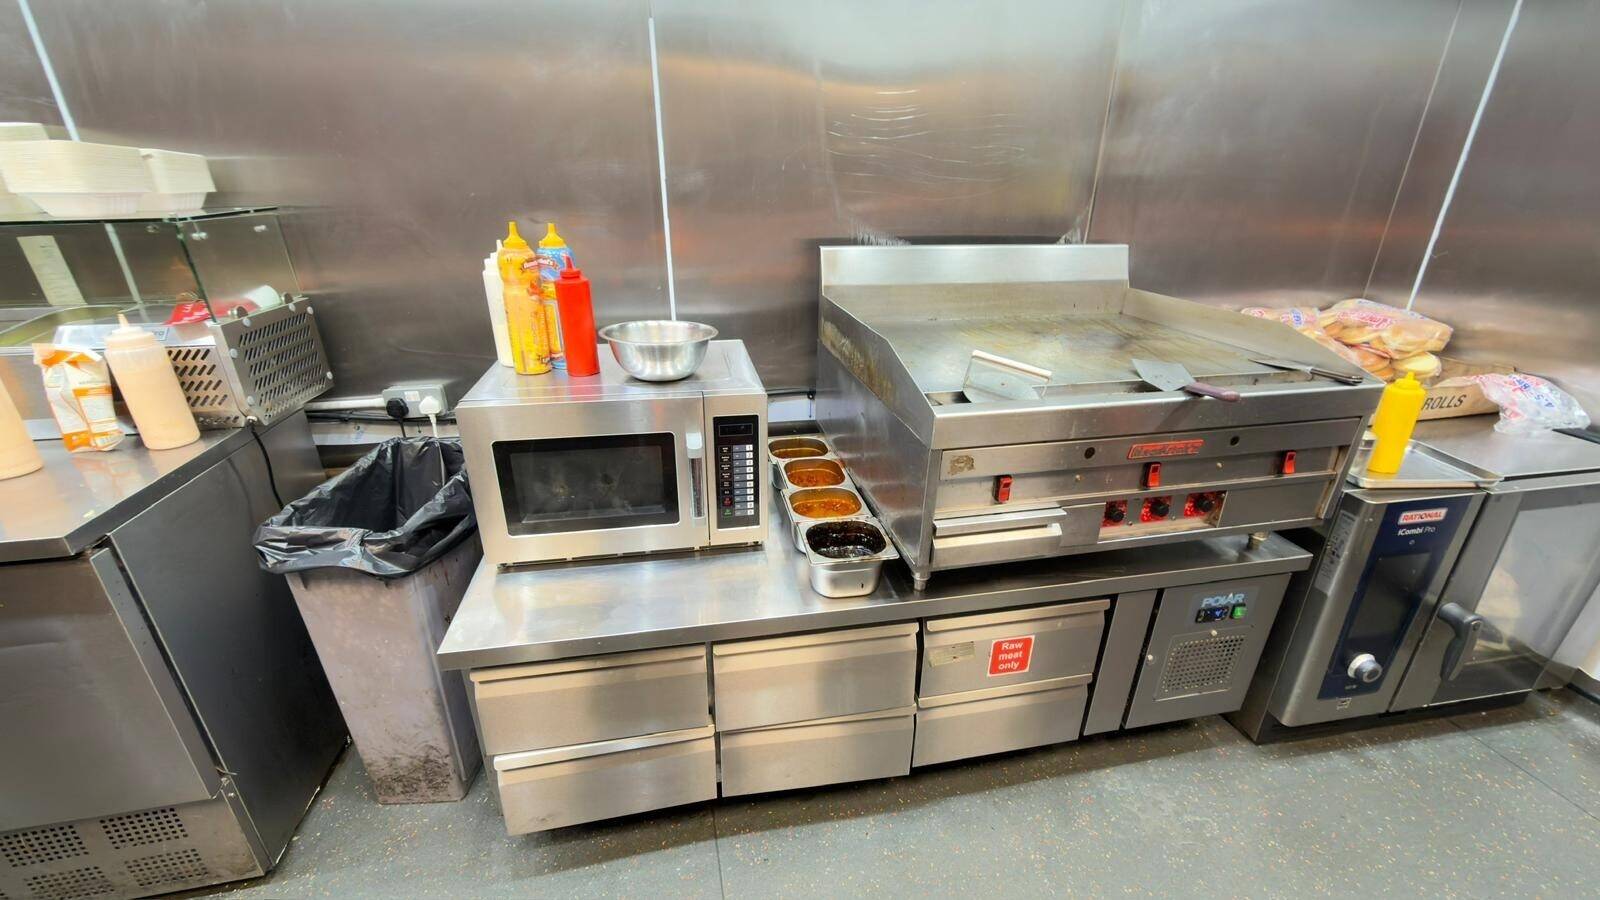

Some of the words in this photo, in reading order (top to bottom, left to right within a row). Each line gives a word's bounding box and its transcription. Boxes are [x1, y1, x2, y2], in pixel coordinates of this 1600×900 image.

[1421, 394, 1467, 411] ROLLS
[1402, 511, 1442, 521] RATIONAL
[1201, 593, 1245, 607] POLAR
[1002, 641, 1024, 650] Raw
[999, 651, 1023, 661] meat
[998, 661, 1020, 670] only
